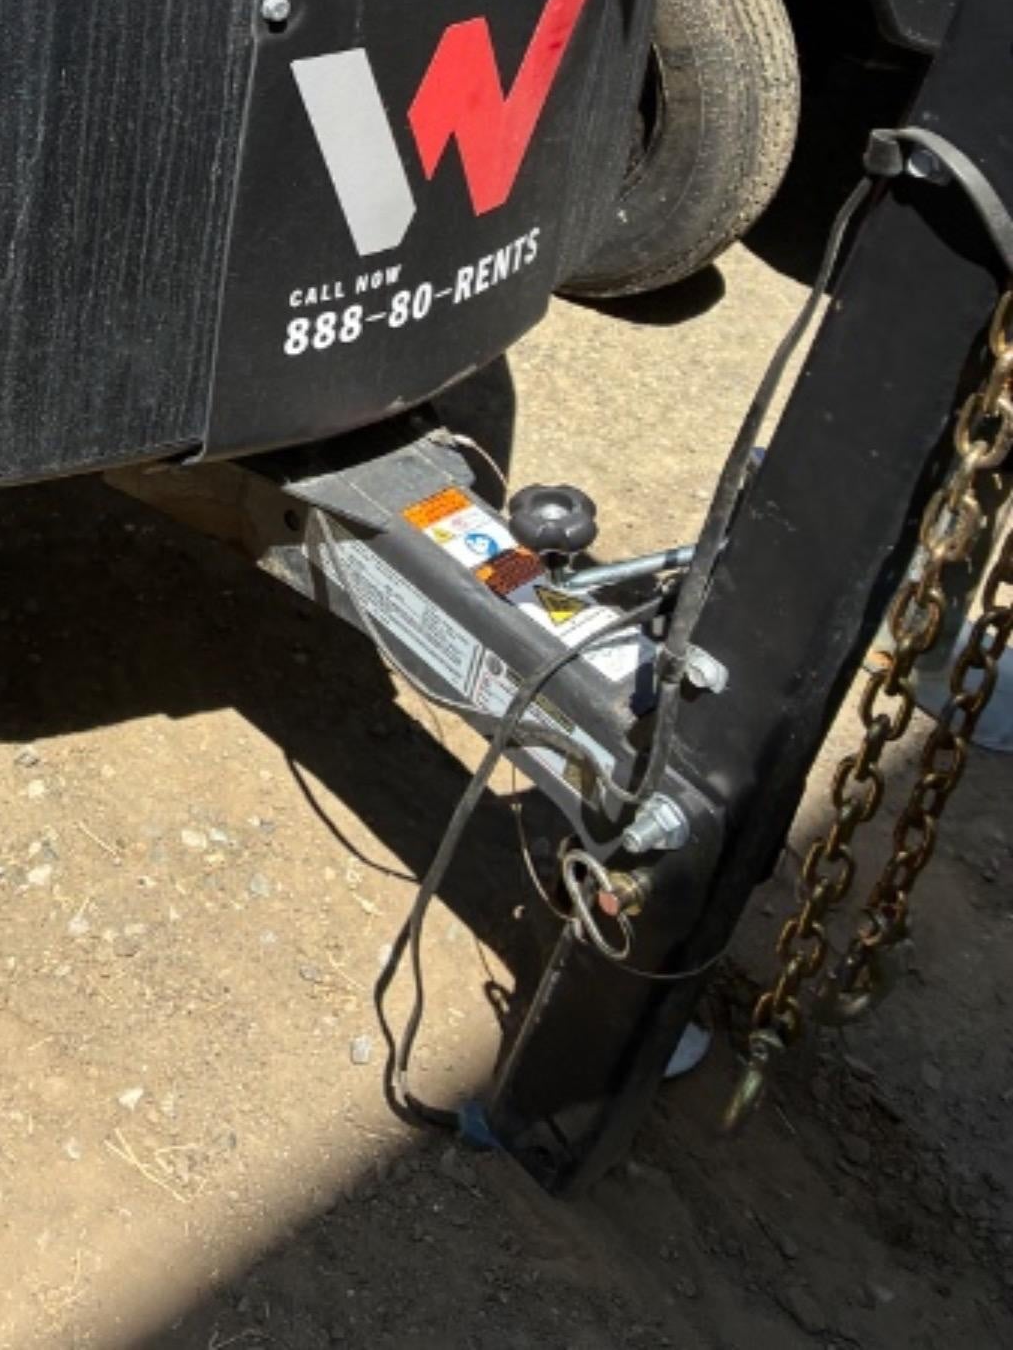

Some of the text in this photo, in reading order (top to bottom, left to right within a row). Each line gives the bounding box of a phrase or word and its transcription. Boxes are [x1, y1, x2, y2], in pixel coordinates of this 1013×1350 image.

[284, 227, 540, 355] 888-80-RENTS
[289, 264, 403, 308] CALL NOW
